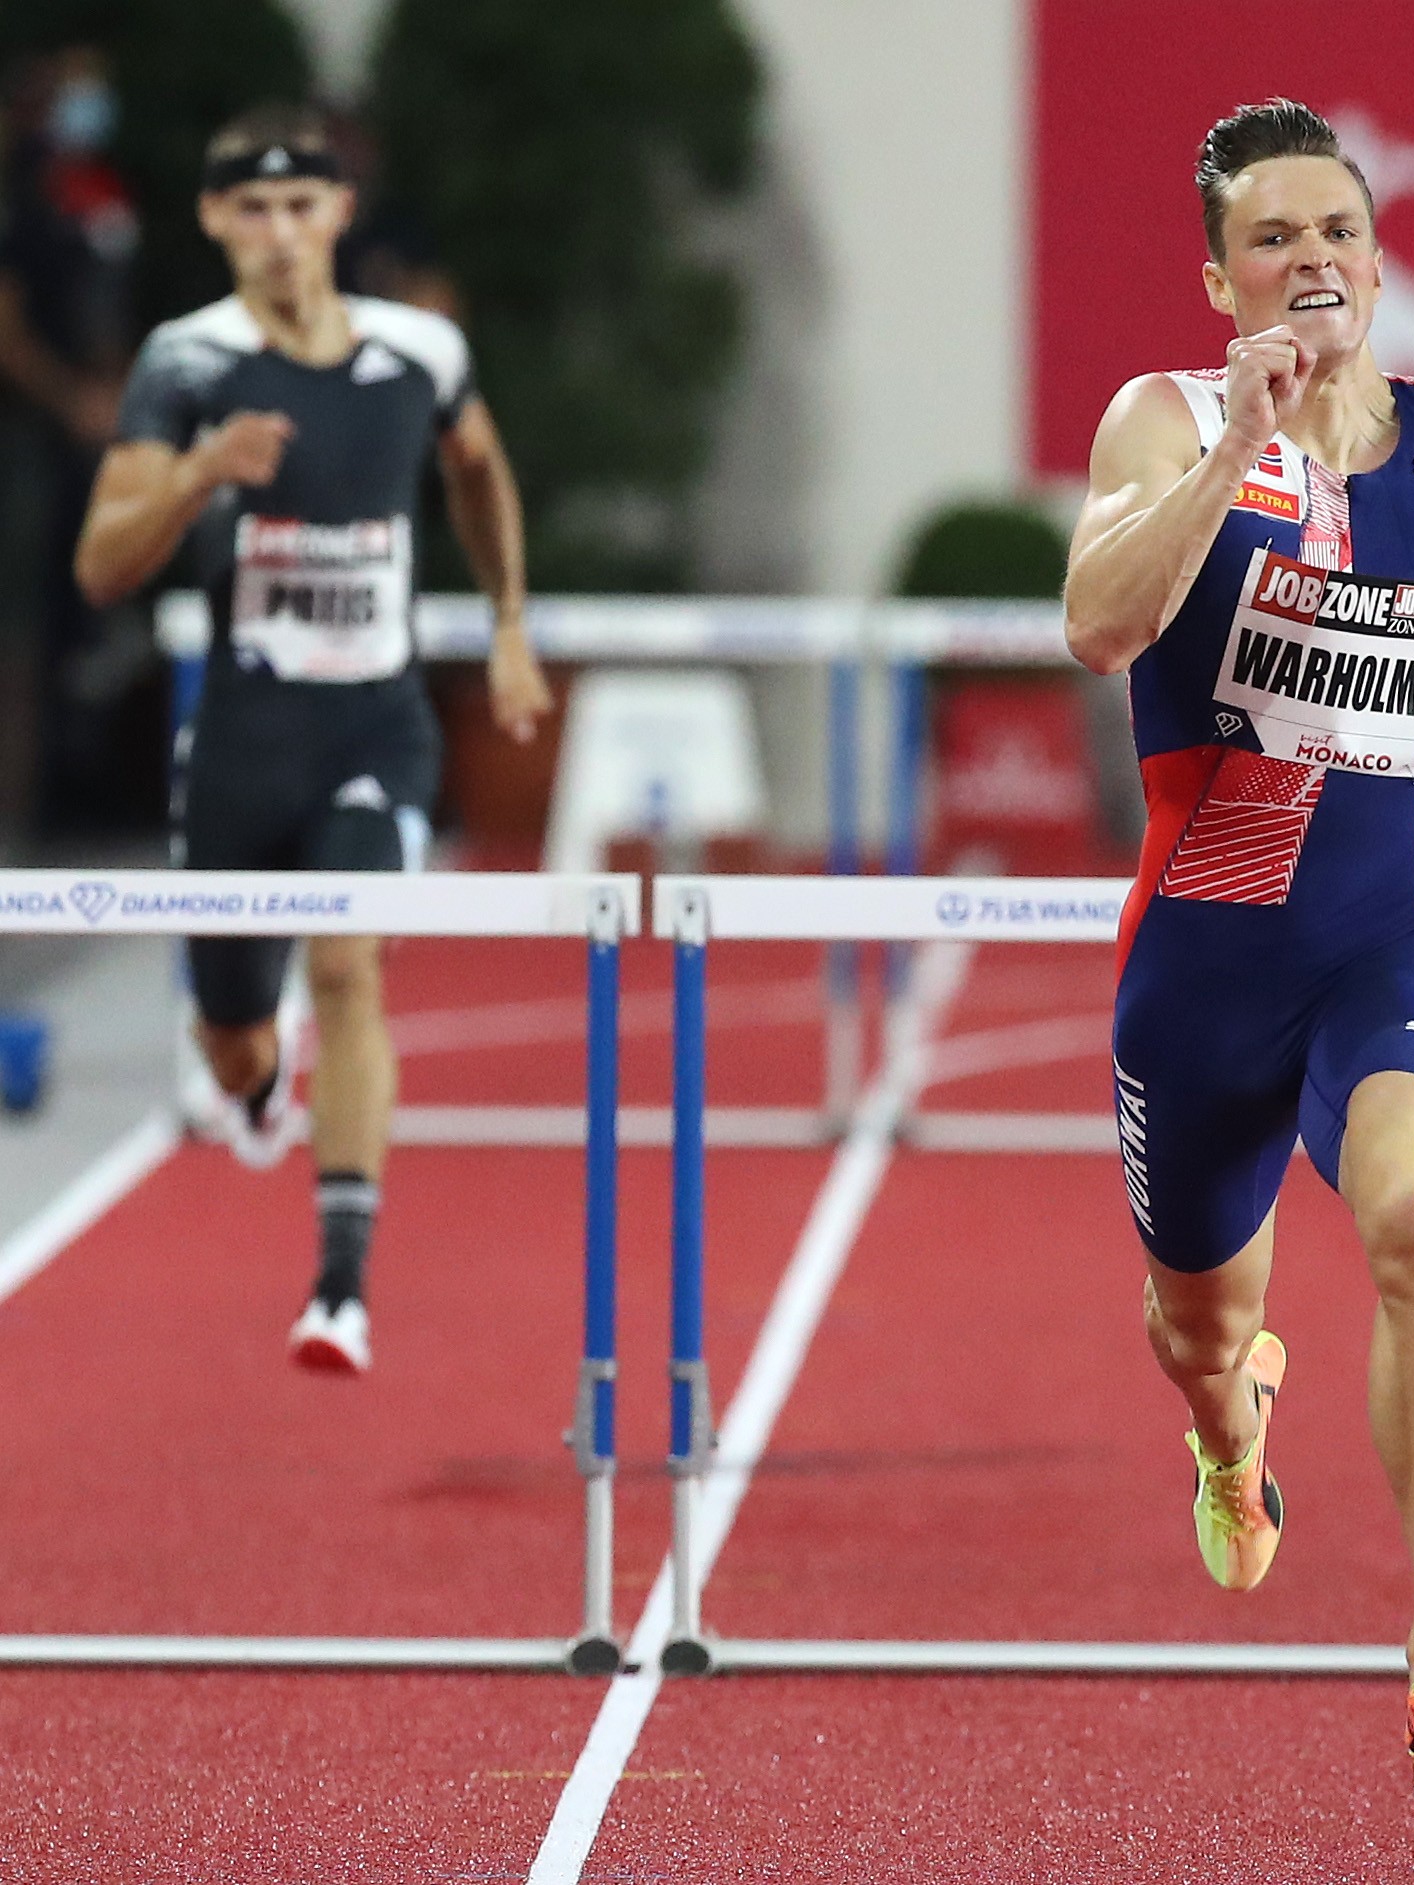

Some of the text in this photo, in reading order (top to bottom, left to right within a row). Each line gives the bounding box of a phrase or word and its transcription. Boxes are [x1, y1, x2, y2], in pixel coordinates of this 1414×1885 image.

[1247, 489, 1294, 512] EXTRA
[1295, 742, 1392, 771] MONACO
[120, 892, 243, 916] DIAMOND
[250, 892, 350, 916] LEAGUE
[1039, 899, 1122, 922] WAND
[1114, 1052, 1155, 1236] NORWAY
